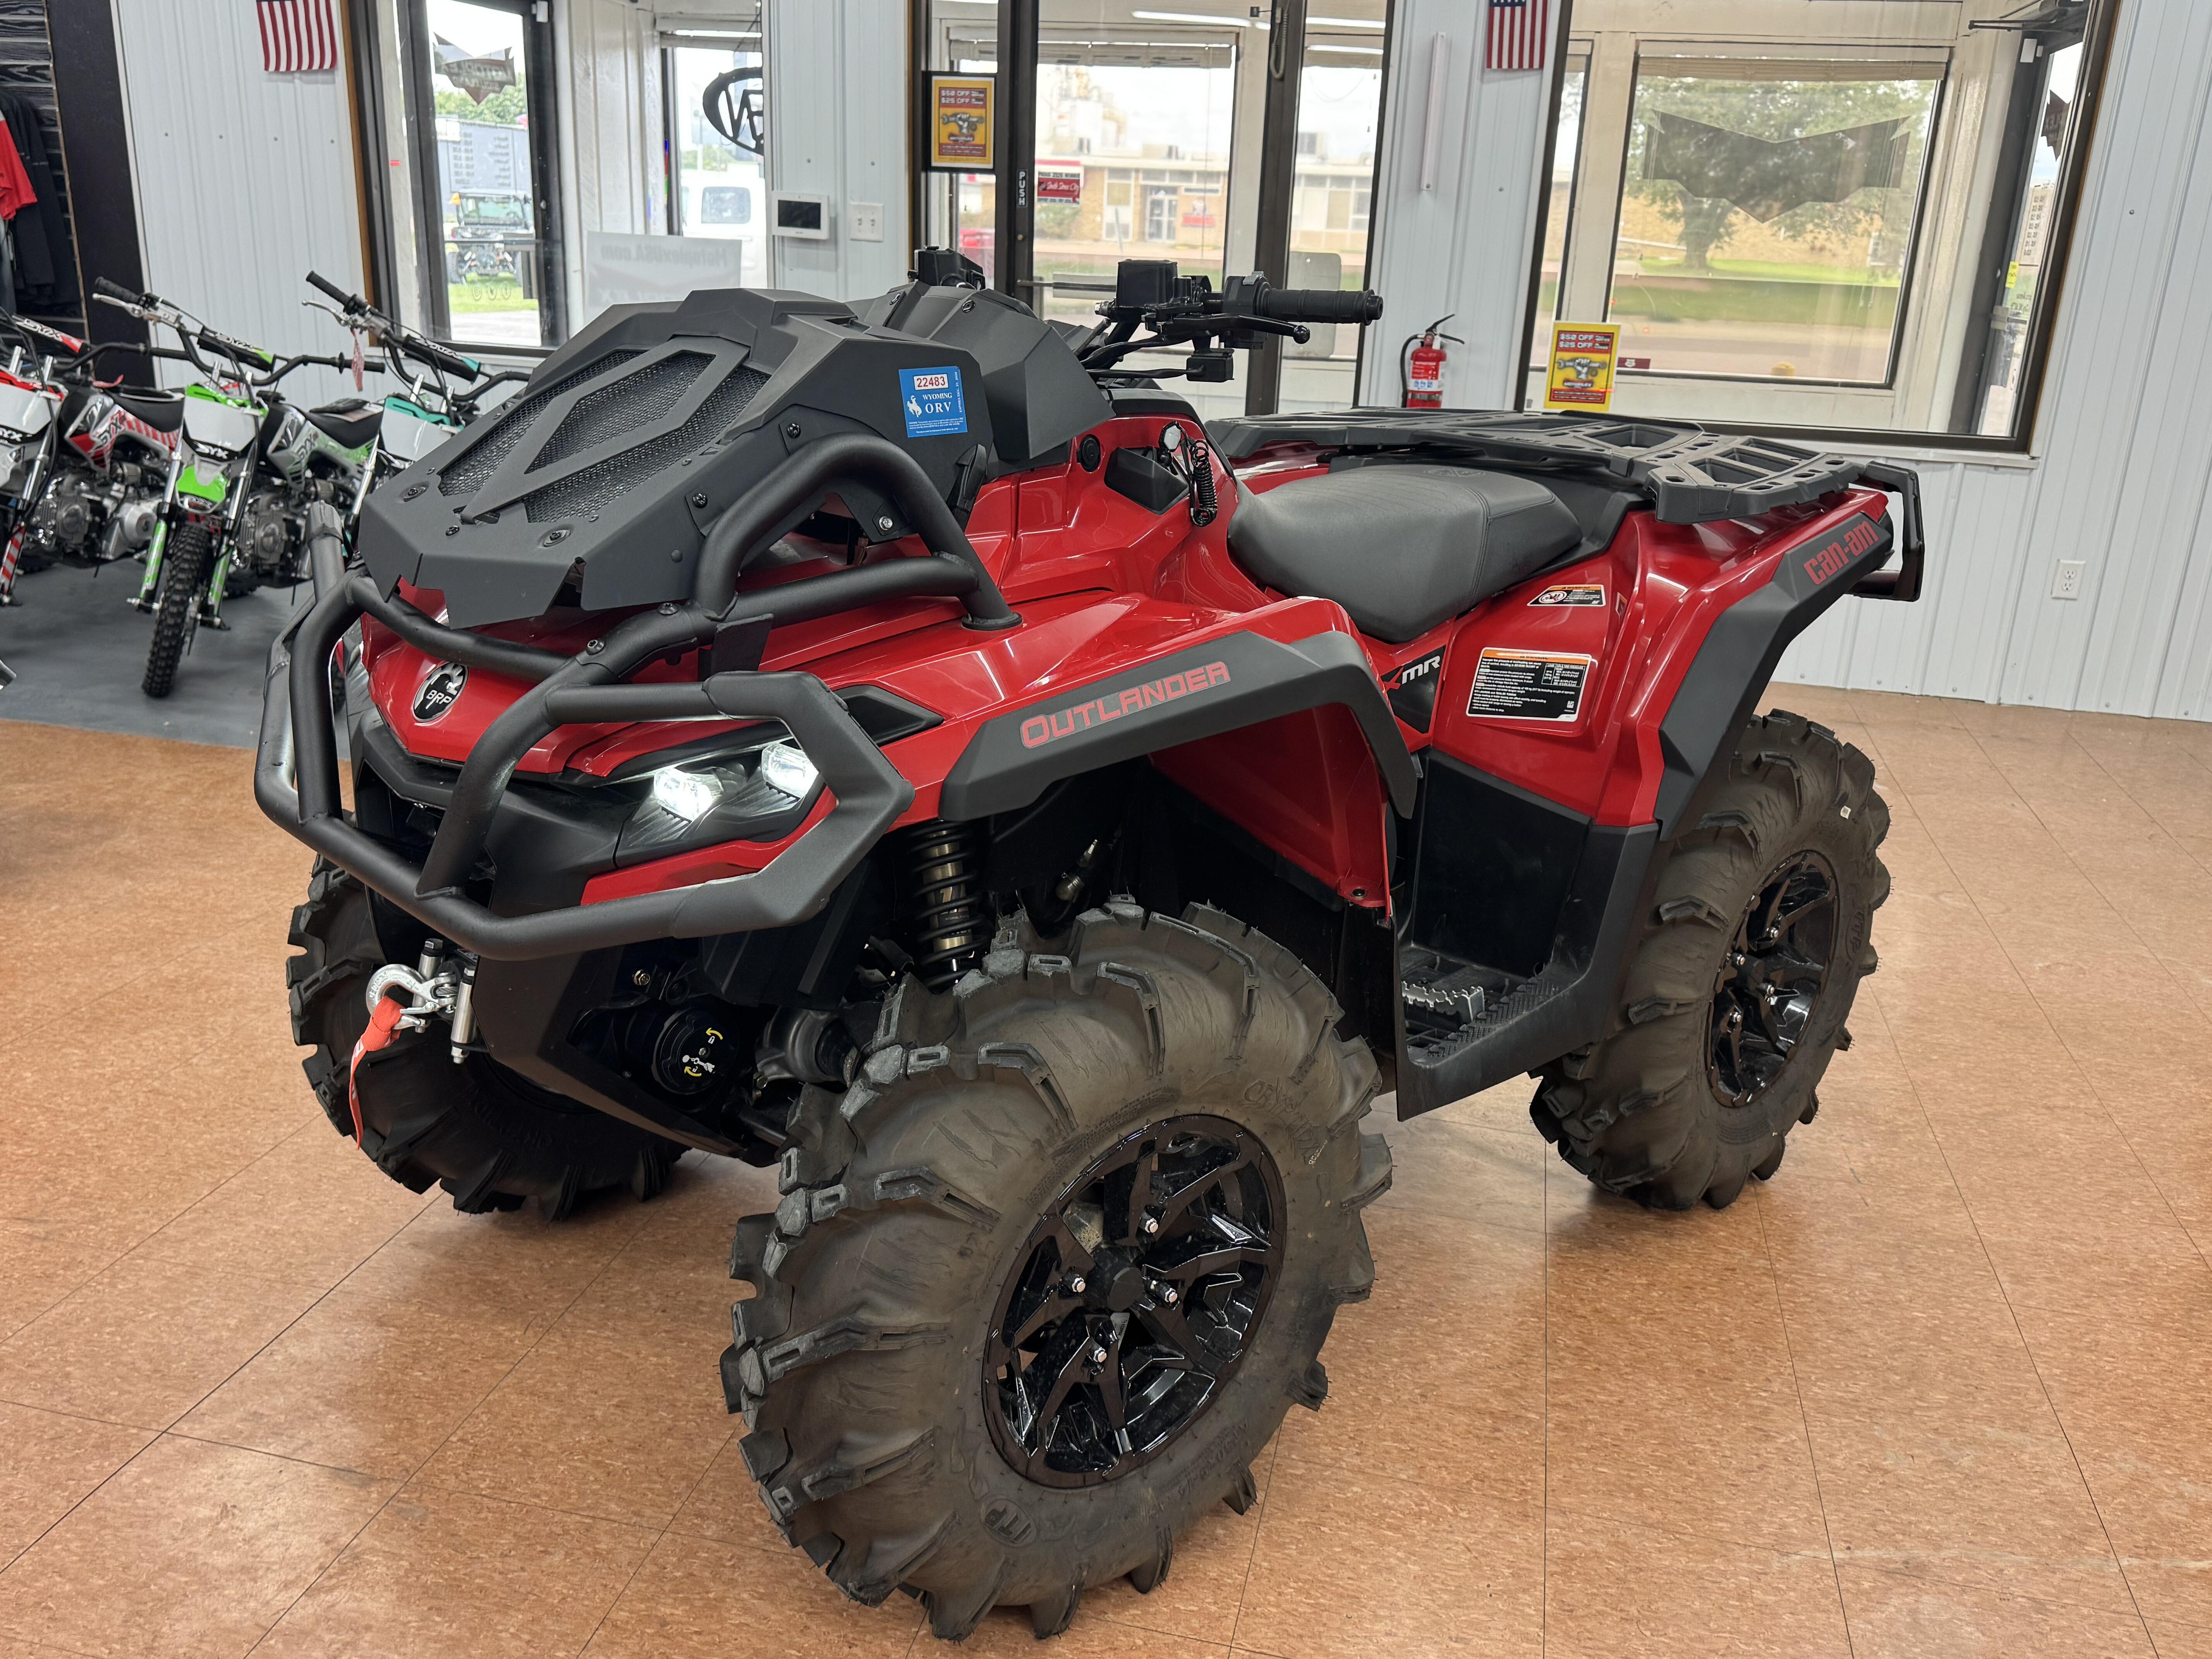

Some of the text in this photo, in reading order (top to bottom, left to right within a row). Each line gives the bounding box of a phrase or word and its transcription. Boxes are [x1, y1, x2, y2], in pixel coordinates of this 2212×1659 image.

[917, 376, 945, 388] 22483
[925, 402, 951, 414] ORV
[1803, 520, 1879, 585] can-am
[426, 690, 453, 709] BRP
[1022, 661, 1231, 748] OUTLANDER
